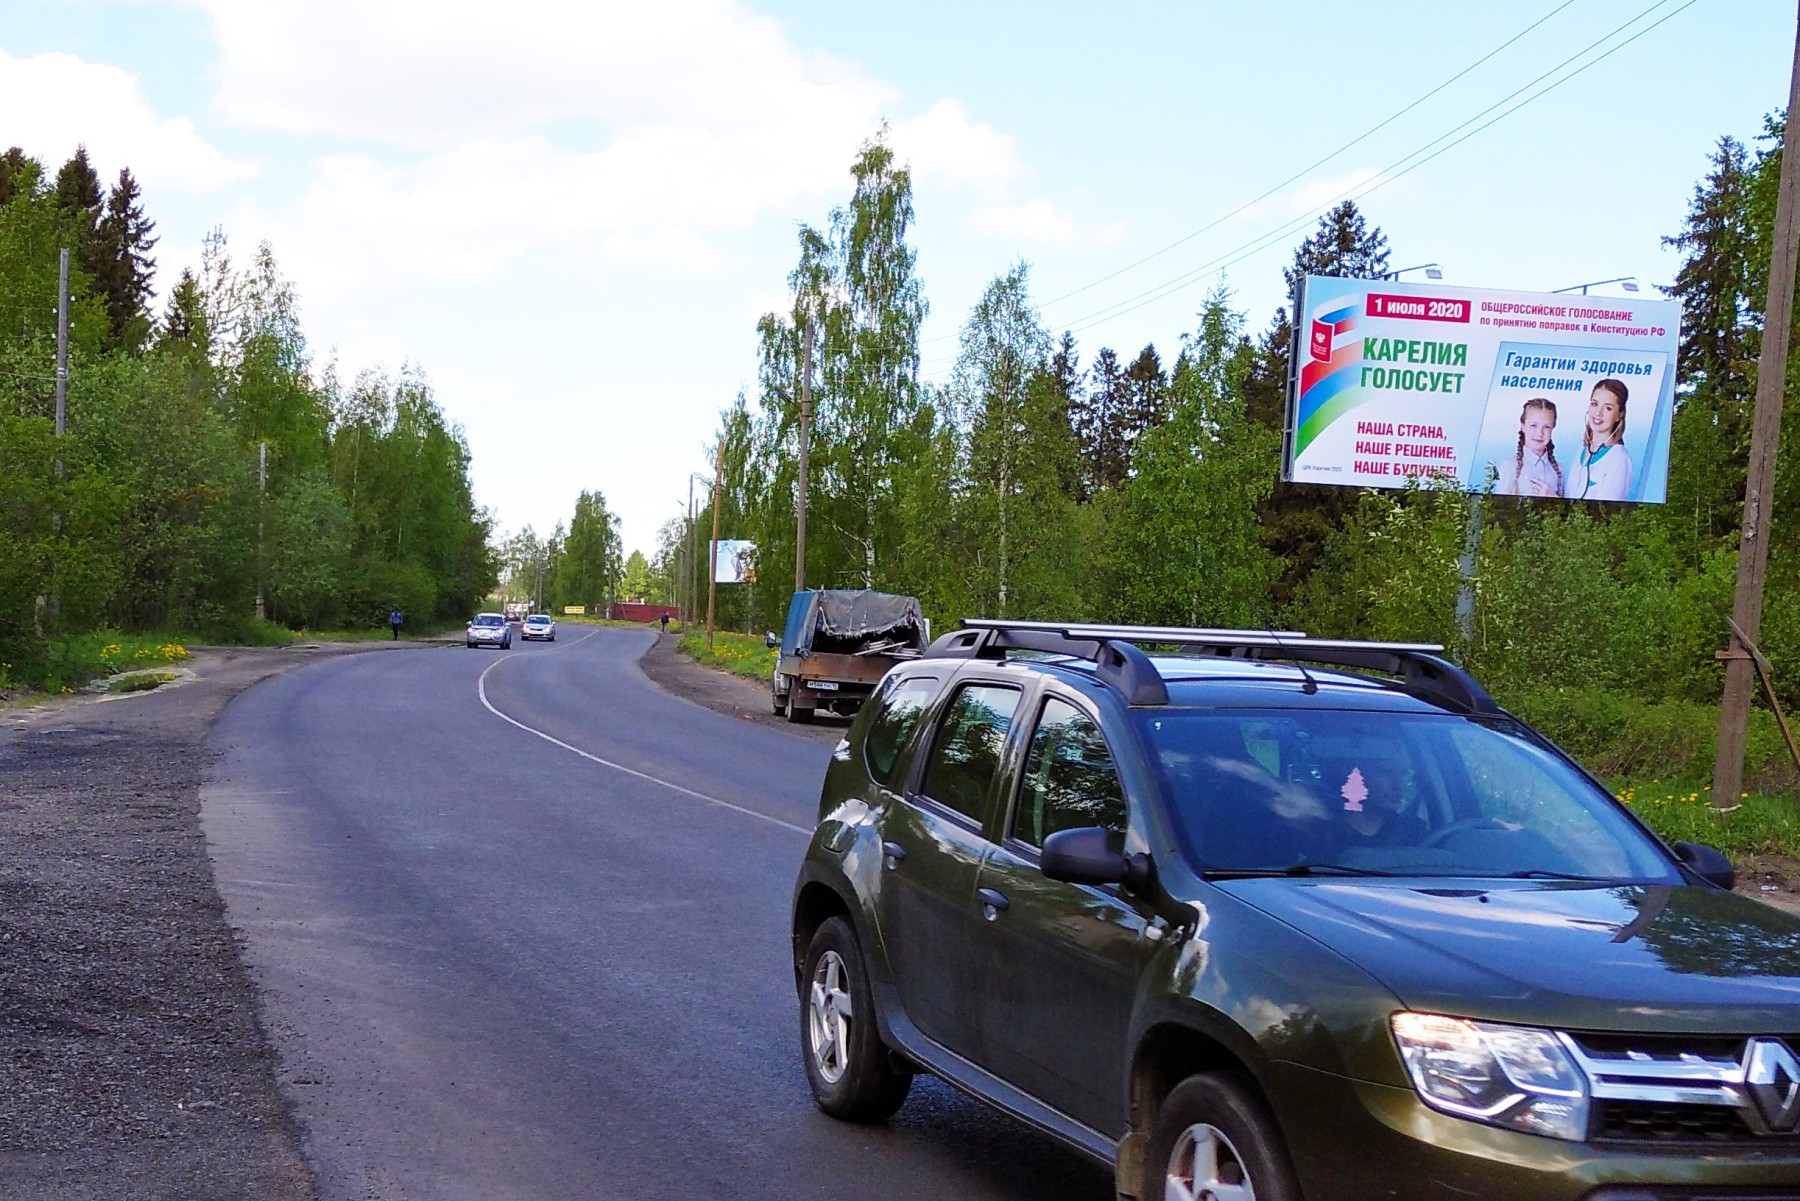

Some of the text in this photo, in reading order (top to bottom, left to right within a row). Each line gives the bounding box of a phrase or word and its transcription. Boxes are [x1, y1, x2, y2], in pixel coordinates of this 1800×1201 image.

[1375, 298, 1463, 318] 1 июля 2020
[1481, 301, 1633, 321] ОБЩЕРОССИЙСКОЕ ГОЛОСОВАНИЕ
[1480, 317, 1491, 325] по
[1493, 318, 1536, 329] принятию
[1539, 322, 1580, 332] поправок
[1590, 323, 1648, 337] Конституцию
[1650, 327, 1666, 336] РФ
[1363, 337, 1468, 366] КАРЕЛИЯ
[1505, 351, 1653, 376] Гарантии здоровья
[1360, 367, 1465, 394] ГОЛОСУЕТ
[1500, 374, 1583, 392] населения
[1357, 421, 1447, 441] НАША СТРАНА,
[1355, 441, 1457, 461] НАШЕ РЕШЕНИЕ,
[1354, 460, 1390, 475] НАШЕ
